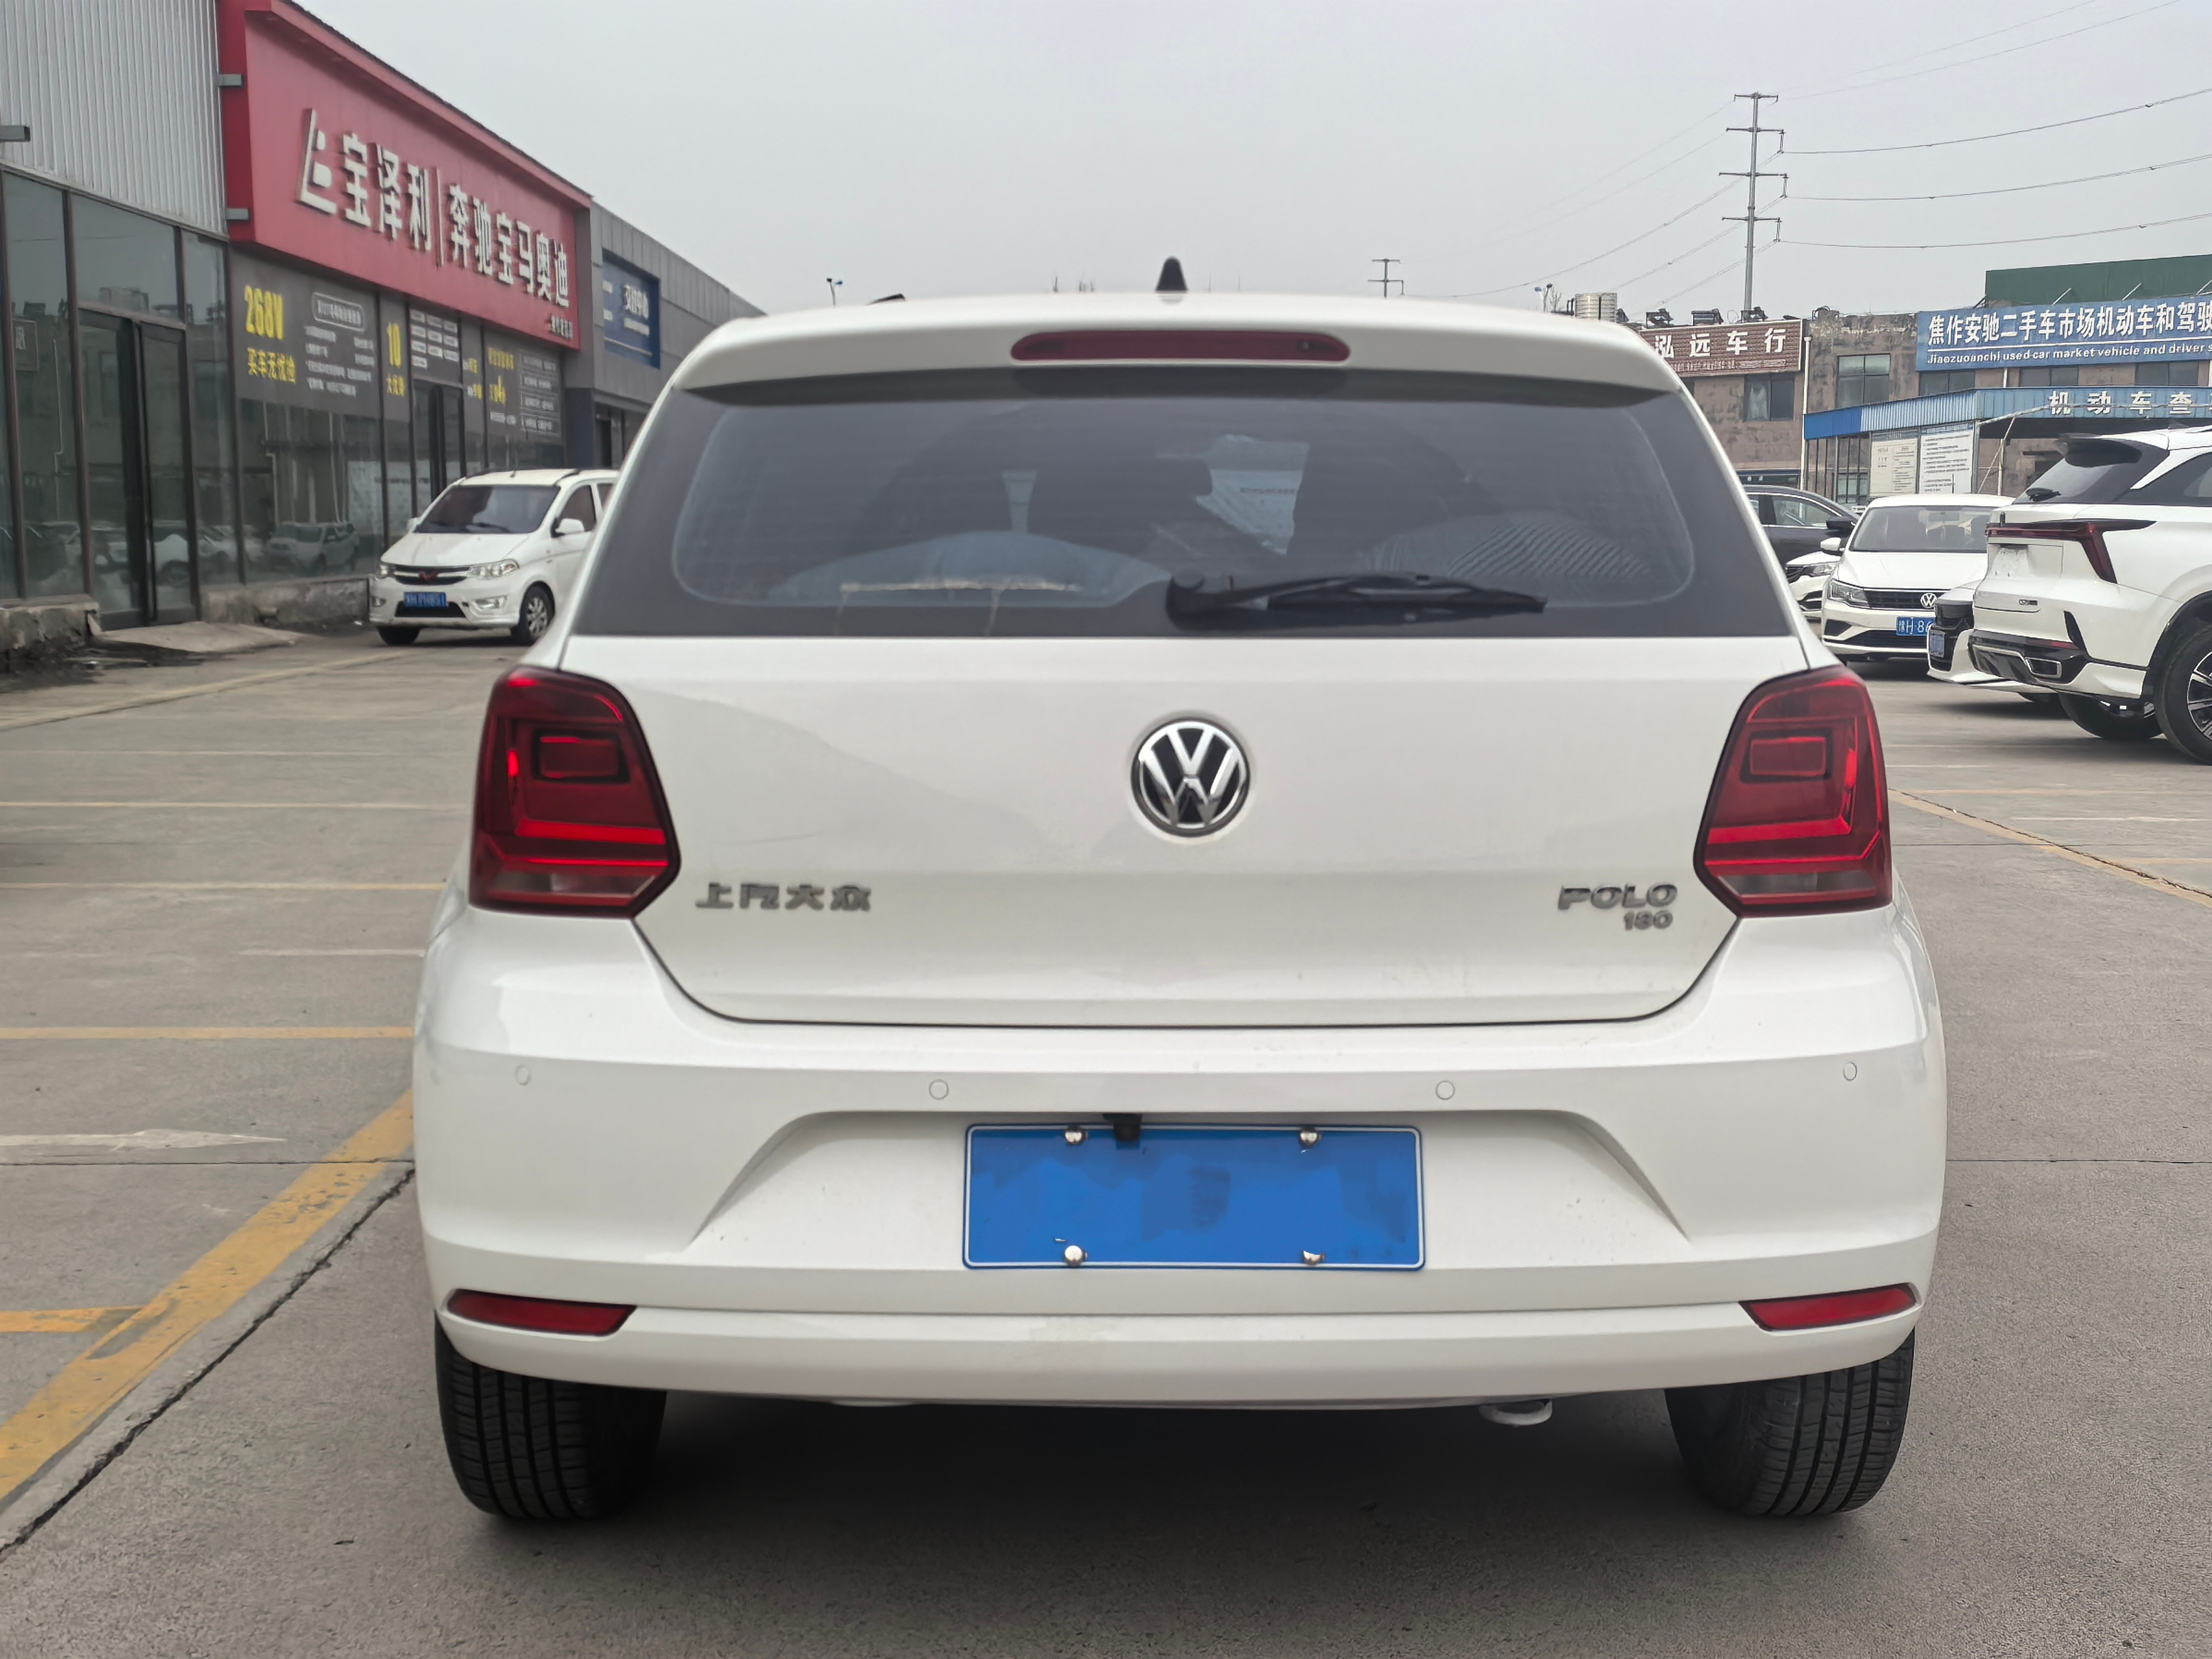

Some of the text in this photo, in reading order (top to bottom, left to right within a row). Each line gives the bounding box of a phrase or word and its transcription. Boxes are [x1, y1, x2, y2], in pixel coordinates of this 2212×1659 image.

[343, 132, 569, 308] 宝泽利 奔驰宝马奥迪
[1655, 327, 1786, 358] 泓远车行
[2003, 349, 2030, 361] used
[2032, 351, 2050, 360] car
[2053, 348, 2095, 359] market
[2099, 345, 2140, 357] vehicle
[2143, 345, 2166, 355] and
[2169, 343, 2205, 353] driver
[2049, 390, 2212, 415] 机动车查
[1557, 884, 1677, 910] POLO
